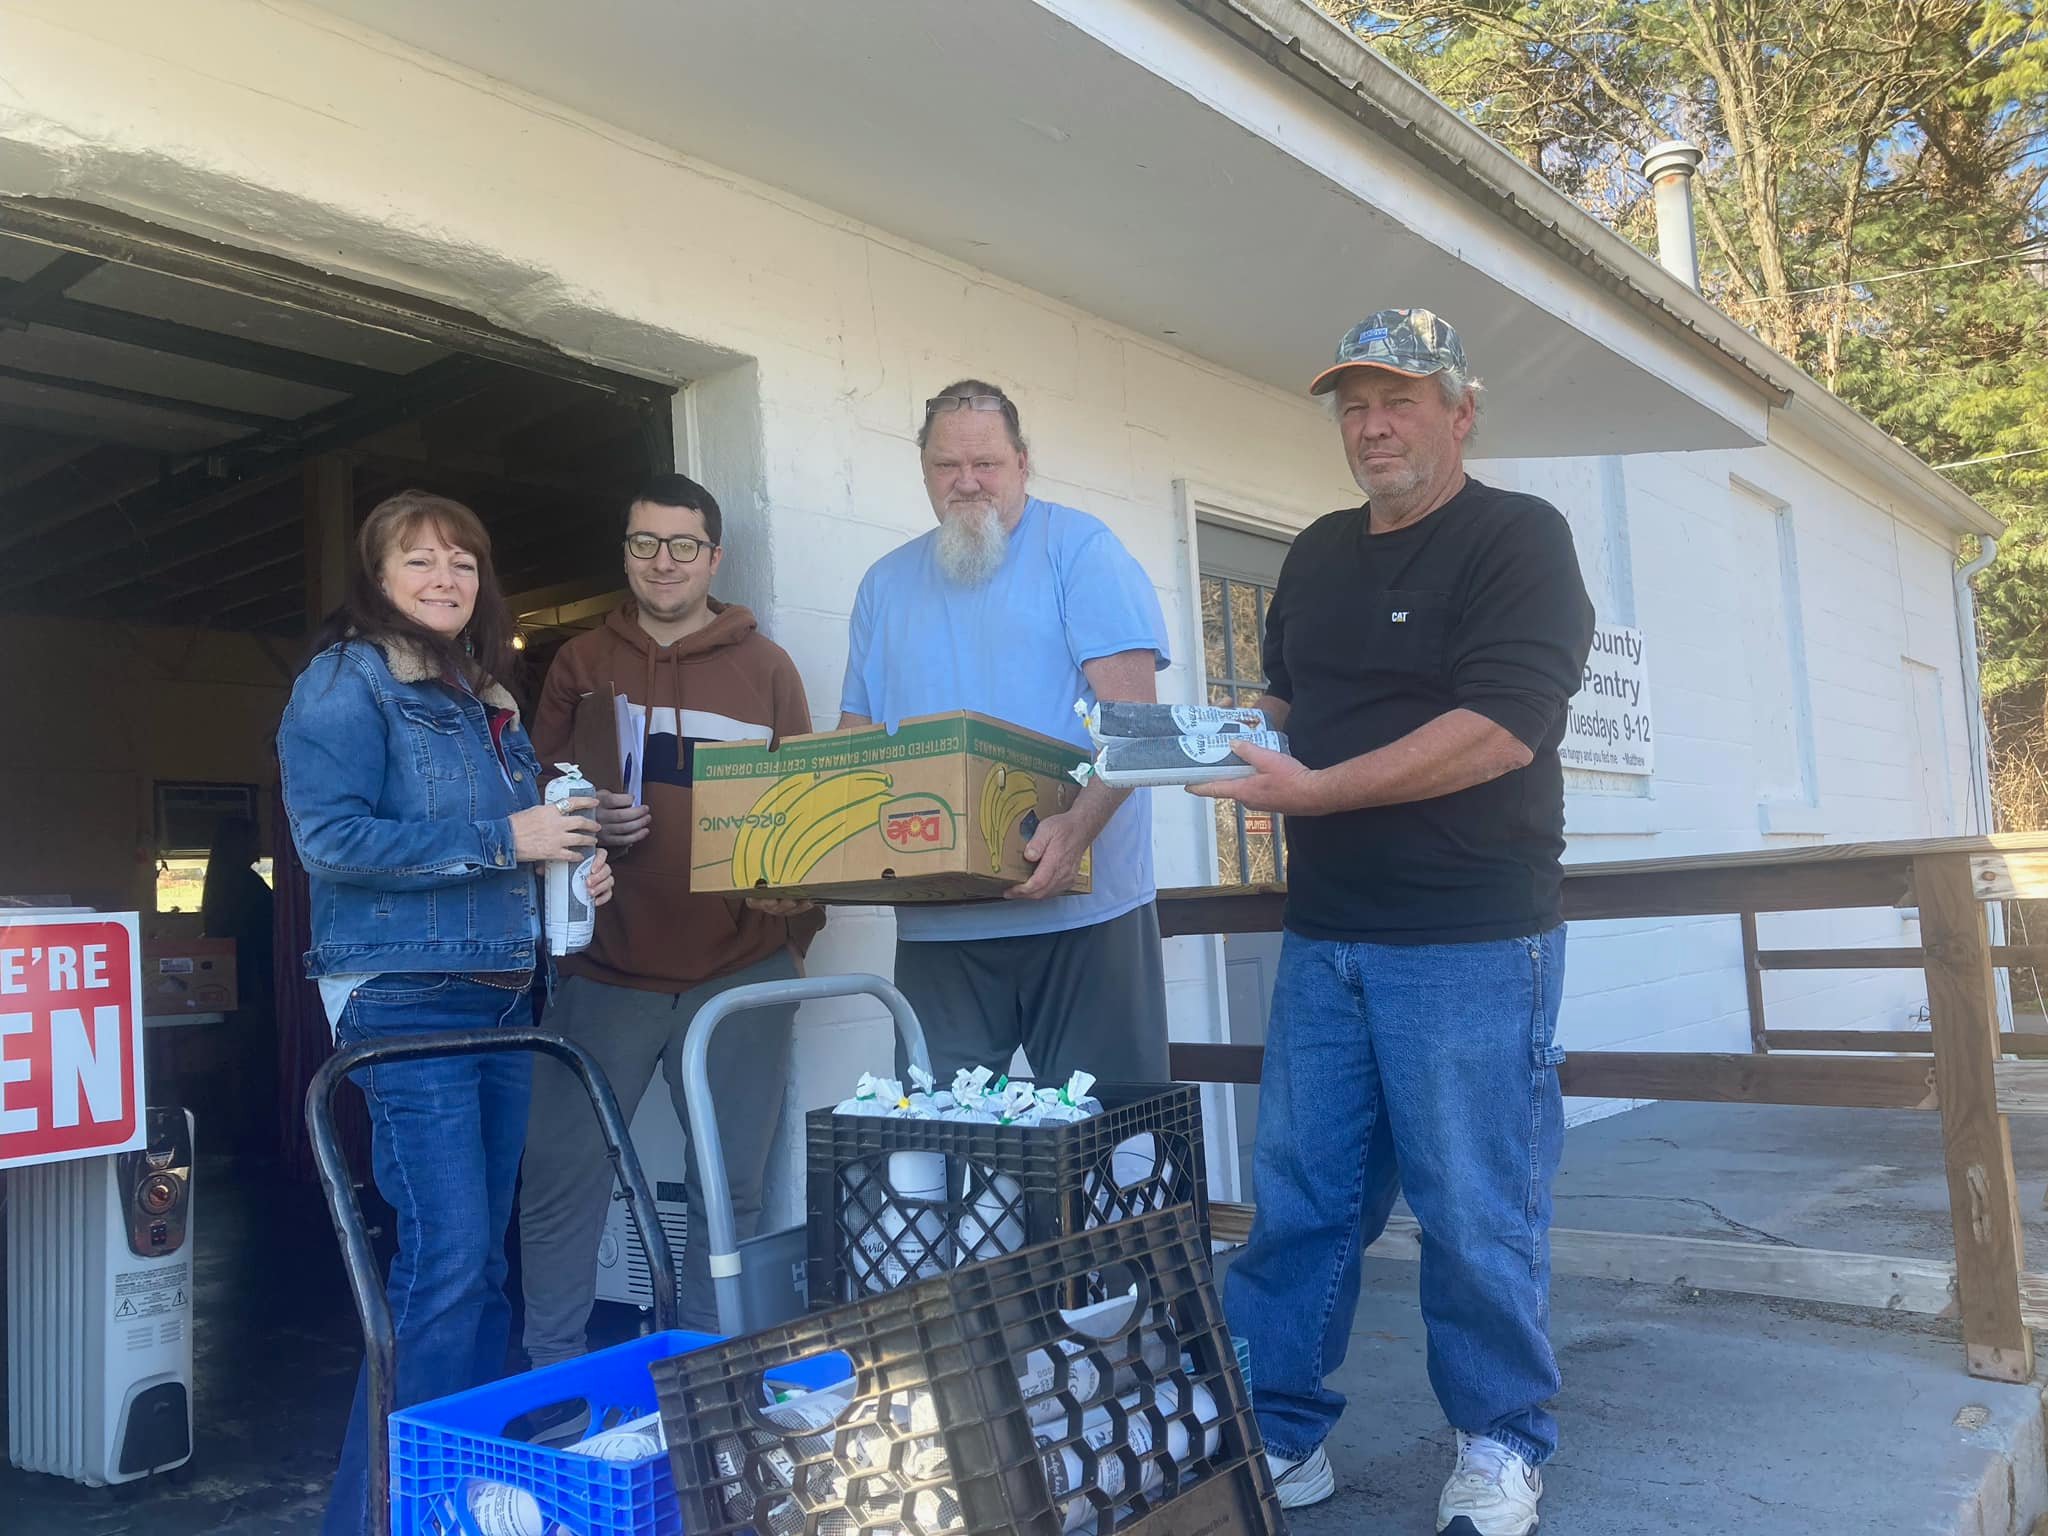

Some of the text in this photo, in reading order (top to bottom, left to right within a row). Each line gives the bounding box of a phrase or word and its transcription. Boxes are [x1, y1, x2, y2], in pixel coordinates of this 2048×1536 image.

[1391, 611, 1409, 623] CAT
[1583, 664, 1640, 707] Pantry
[1568, 704, 1651, 746] Tuesdays 9-12
[705, 736, 960, 777] CERTIFIED ORGANIC BANANAS CERTIFIED ORGANIC
[699, 811, 786, 832] ORGANIC
[887, 816, 940, 845] Dole
[0, 943, 110, 995] E'RE
[0, 1005, 123, 1135] EN
